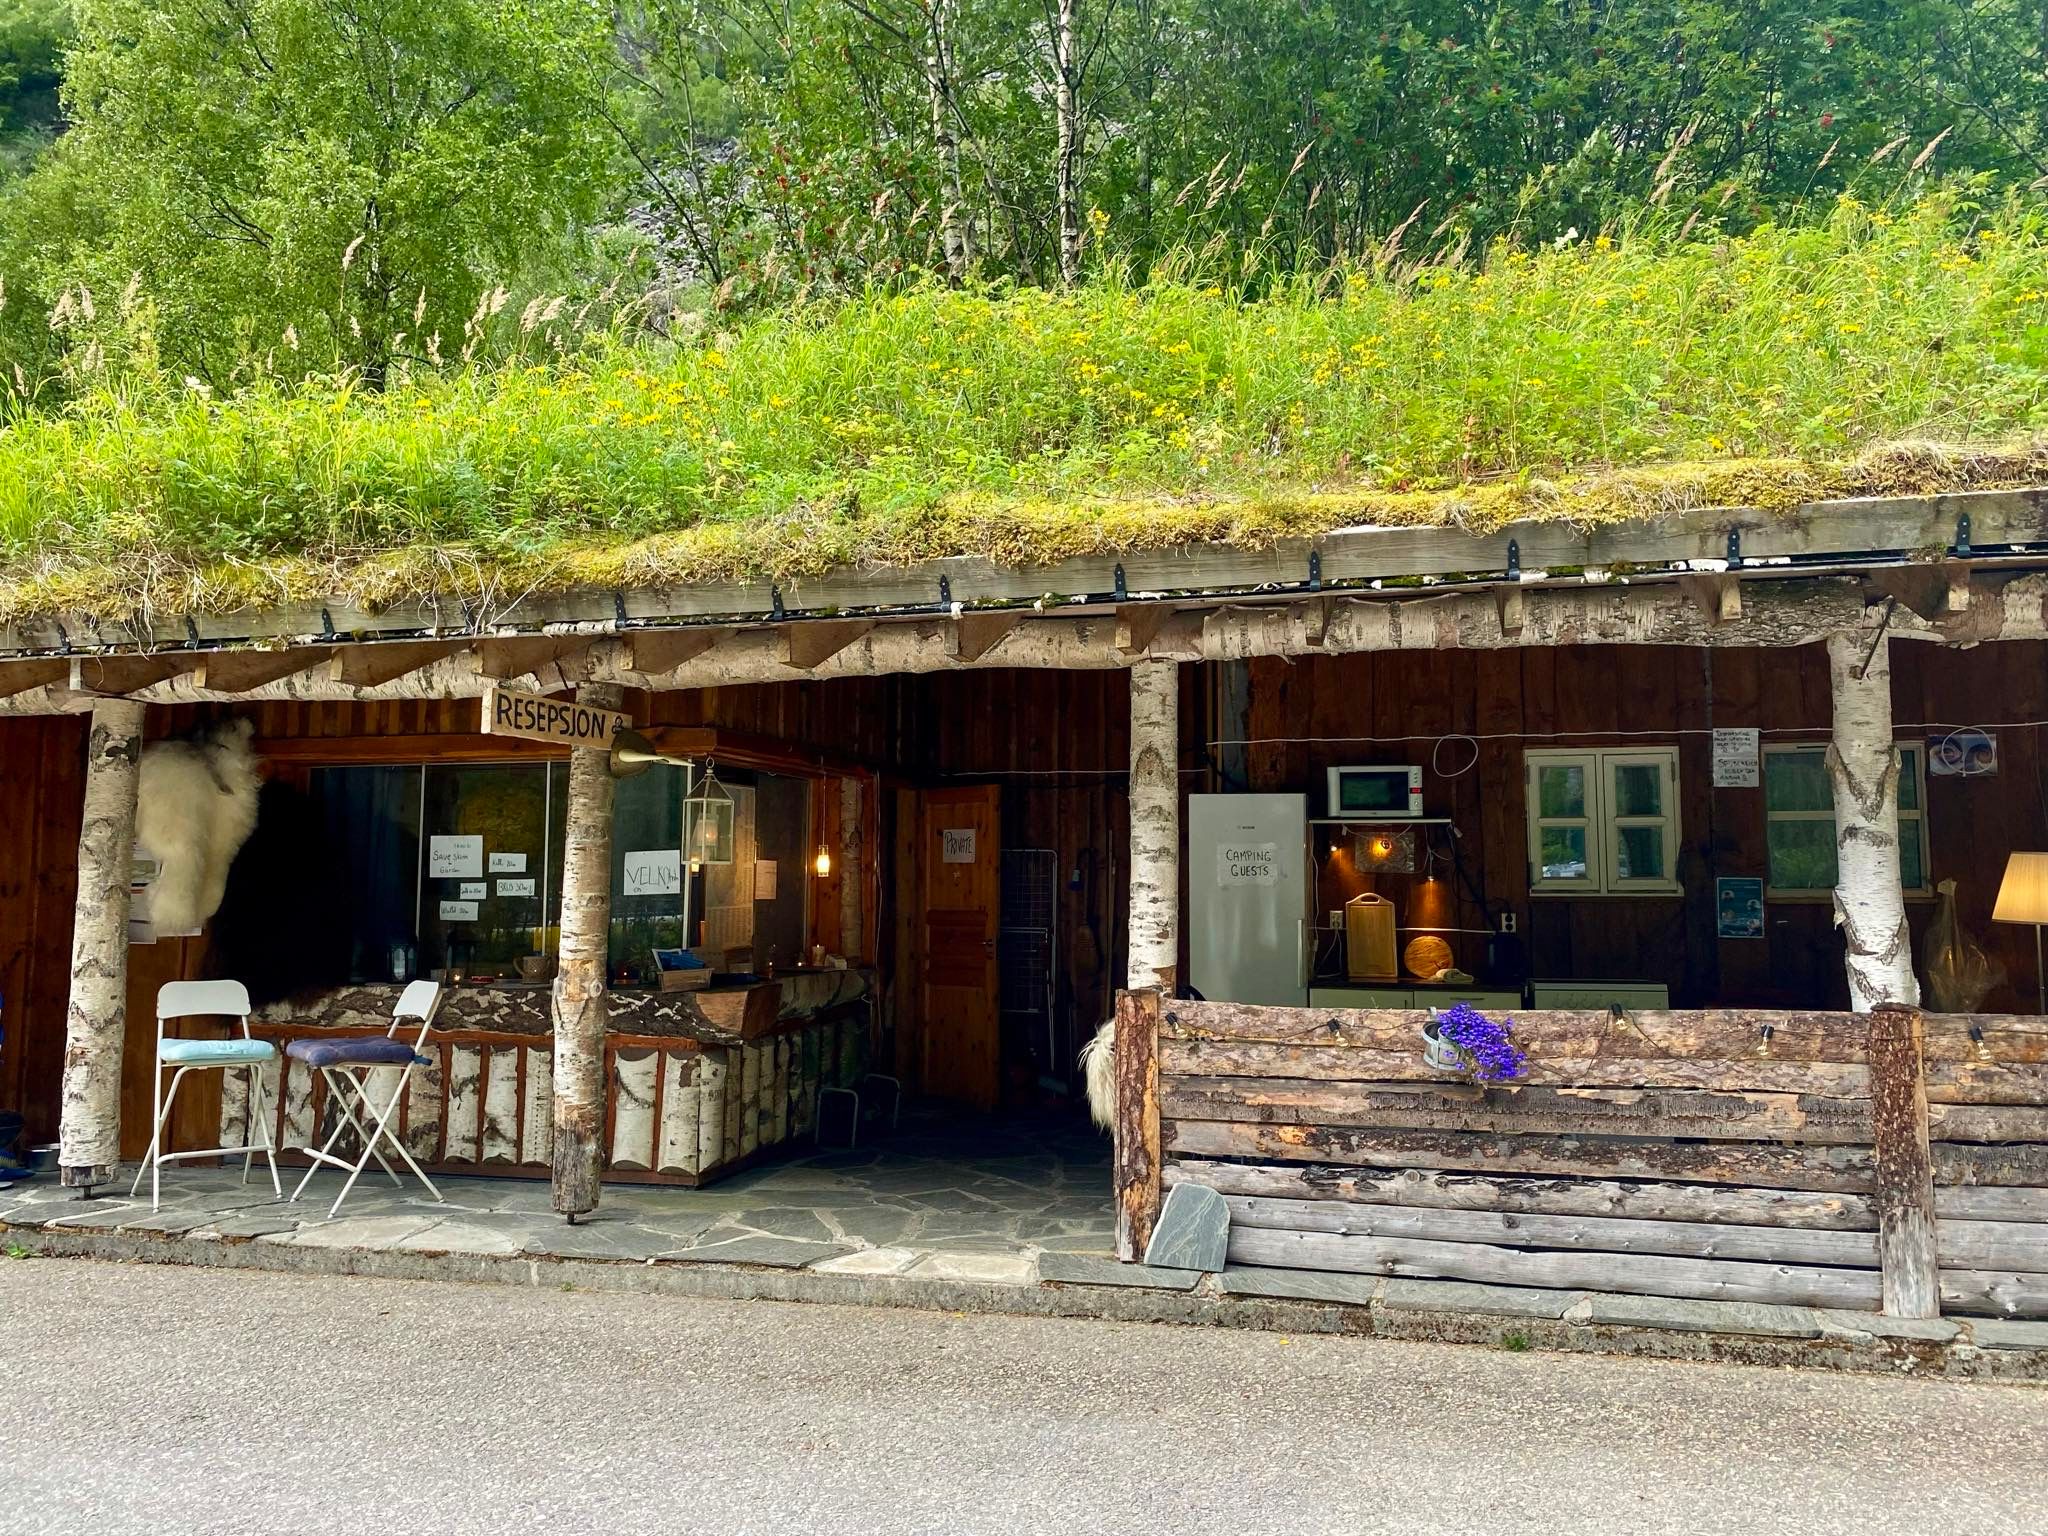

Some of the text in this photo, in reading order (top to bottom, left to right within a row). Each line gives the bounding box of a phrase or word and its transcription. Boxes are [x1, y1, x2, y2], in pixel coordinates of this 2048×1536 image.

[496, 693, 606, 739] RESEPSJON
[945, 831, 972, 855] PRIVATE
[1226, 848, 1271, 862] CAMPING
[1231, 864, 1269, 877] GUESTS
